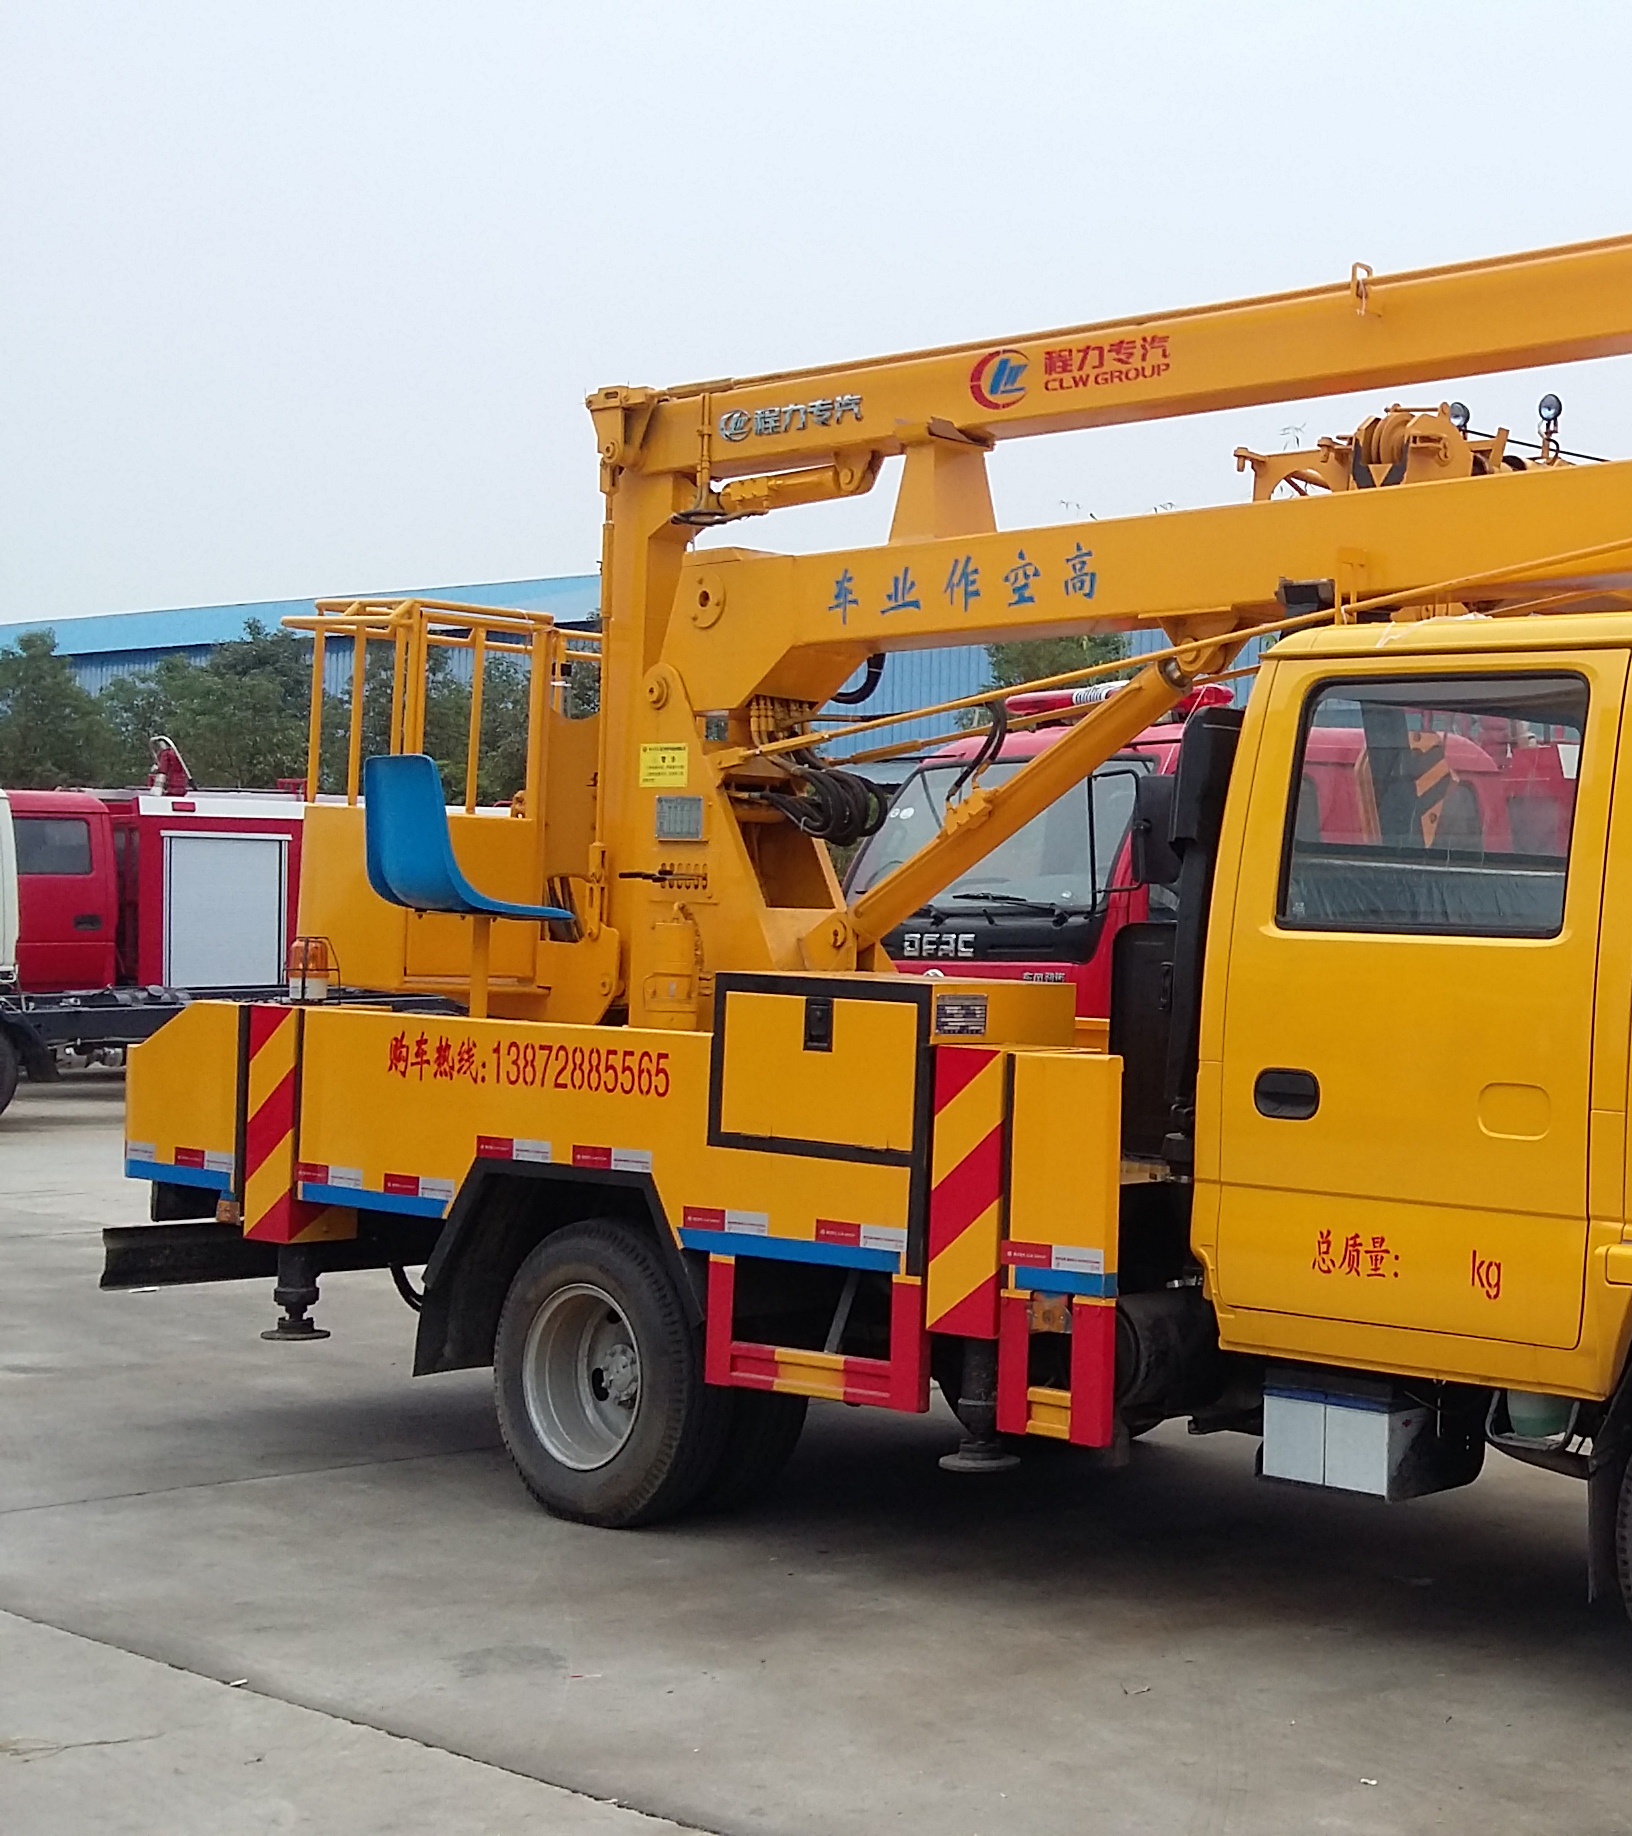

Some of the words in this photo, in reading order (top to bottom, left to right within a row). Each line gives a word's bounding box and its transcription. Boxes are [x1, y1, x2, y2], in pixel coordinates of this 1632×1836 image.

[1044, 334, 1171, 376] 程力专汽
[1044, 373, 1090, 392] CLW
[1094, 362, 1171, 386] GROUP
[753, 394, 864, 436] 程力专汽
[387, 1031, 671, 1098] 购车热线:13872885565
[1312, 1229, 1400, 1278] 总质量:
[1471, 1249, 1502, 1300] kg
